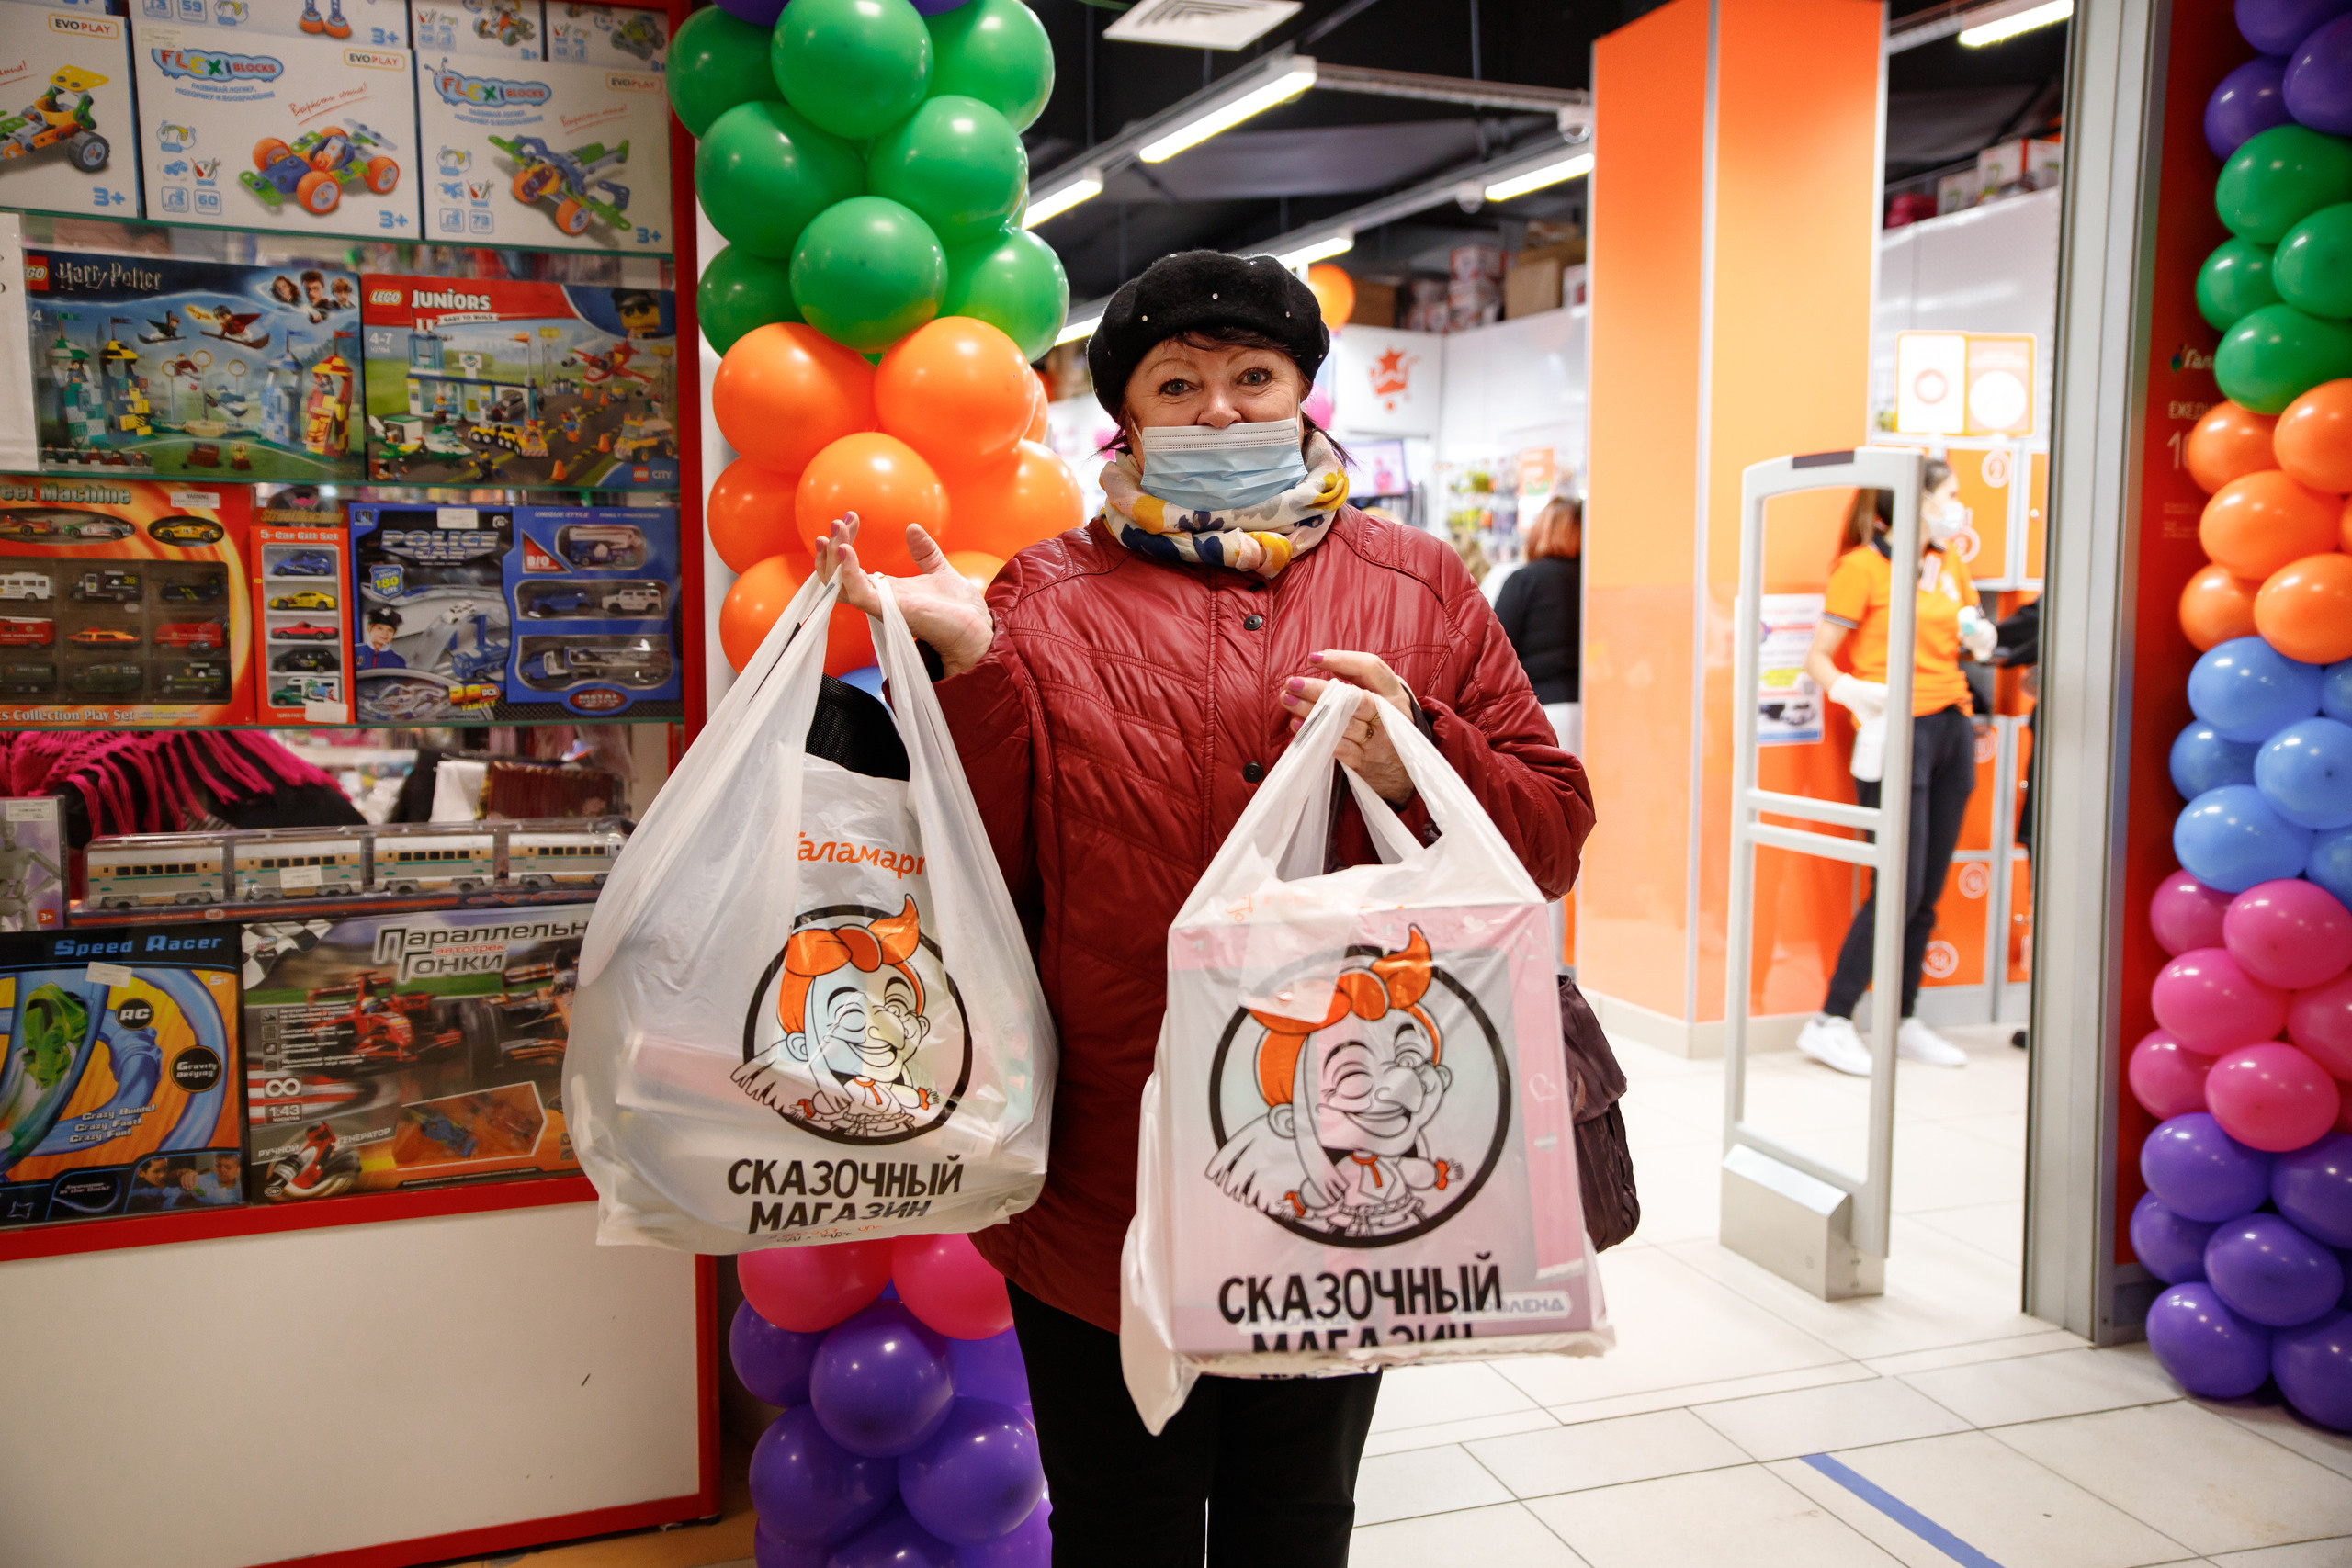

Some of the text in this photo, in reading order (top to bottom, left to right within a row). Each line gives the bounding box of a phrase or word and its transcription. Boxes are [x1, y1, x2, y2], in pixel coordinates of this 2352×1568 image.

[54, 18, 111, 34] EVOPLAY
[370, 27, 399, 45] 3+
[160, 49, 277, 76] FLEXI BLOCKS
[349, 52, 398, 66] EVOPLAY
[442, 76, 545, 102] FLEXI BLOCKS
[93, 187, 126, 207] 3+
[379, 210, 409, 229] 3+
[636, 227, 662, 244] 3+
[55, 262, 107, 291] Harry
[109, 262, 163, 291] Potter
[370, 289, 401, 304] LEGO
[369, 332, 393, 344] 4-7
[0, 483, 132, 504] eet Machine
[320, 532, 339, 540] Set
[380, 530, 501, 548] POLICE
[413, 547, 467, 560] CAR
[375, 575, 400, 590] 180
[13, 709, 81, 721] Collection
[84, 709, 111, 723] Play
[113, 709, 135, 721] Set
[797, 832, 924, 879] аламар
[54, 935, 223, 957] Speed Racer
[374, 919, 590, 963] Параллельн
[435, 943, 505, 955] автотрек
[400, 951, 503, 983] Гонки
[119, 1008, 150, 1021] RC
[176, 1061, 219, 1072] Gravity
[82, 1110, 115, 1122] Crazy
[269, 1104, 300, 1117] 1:43
[74, 1120, 108, 1132] Crazy
[69, 1128, 132, 1143] Crazy Fun!
[337, 1127, 391, 1145] ГЕНЕРАТОР
[727, 1154, 965, 1199] СКАЗОЧНЫЙ
[748, 1200, 933, 1235] МАГАЗИН
[1218, 1252, 1504, 1325] СКАЗОЧНЫЙ
